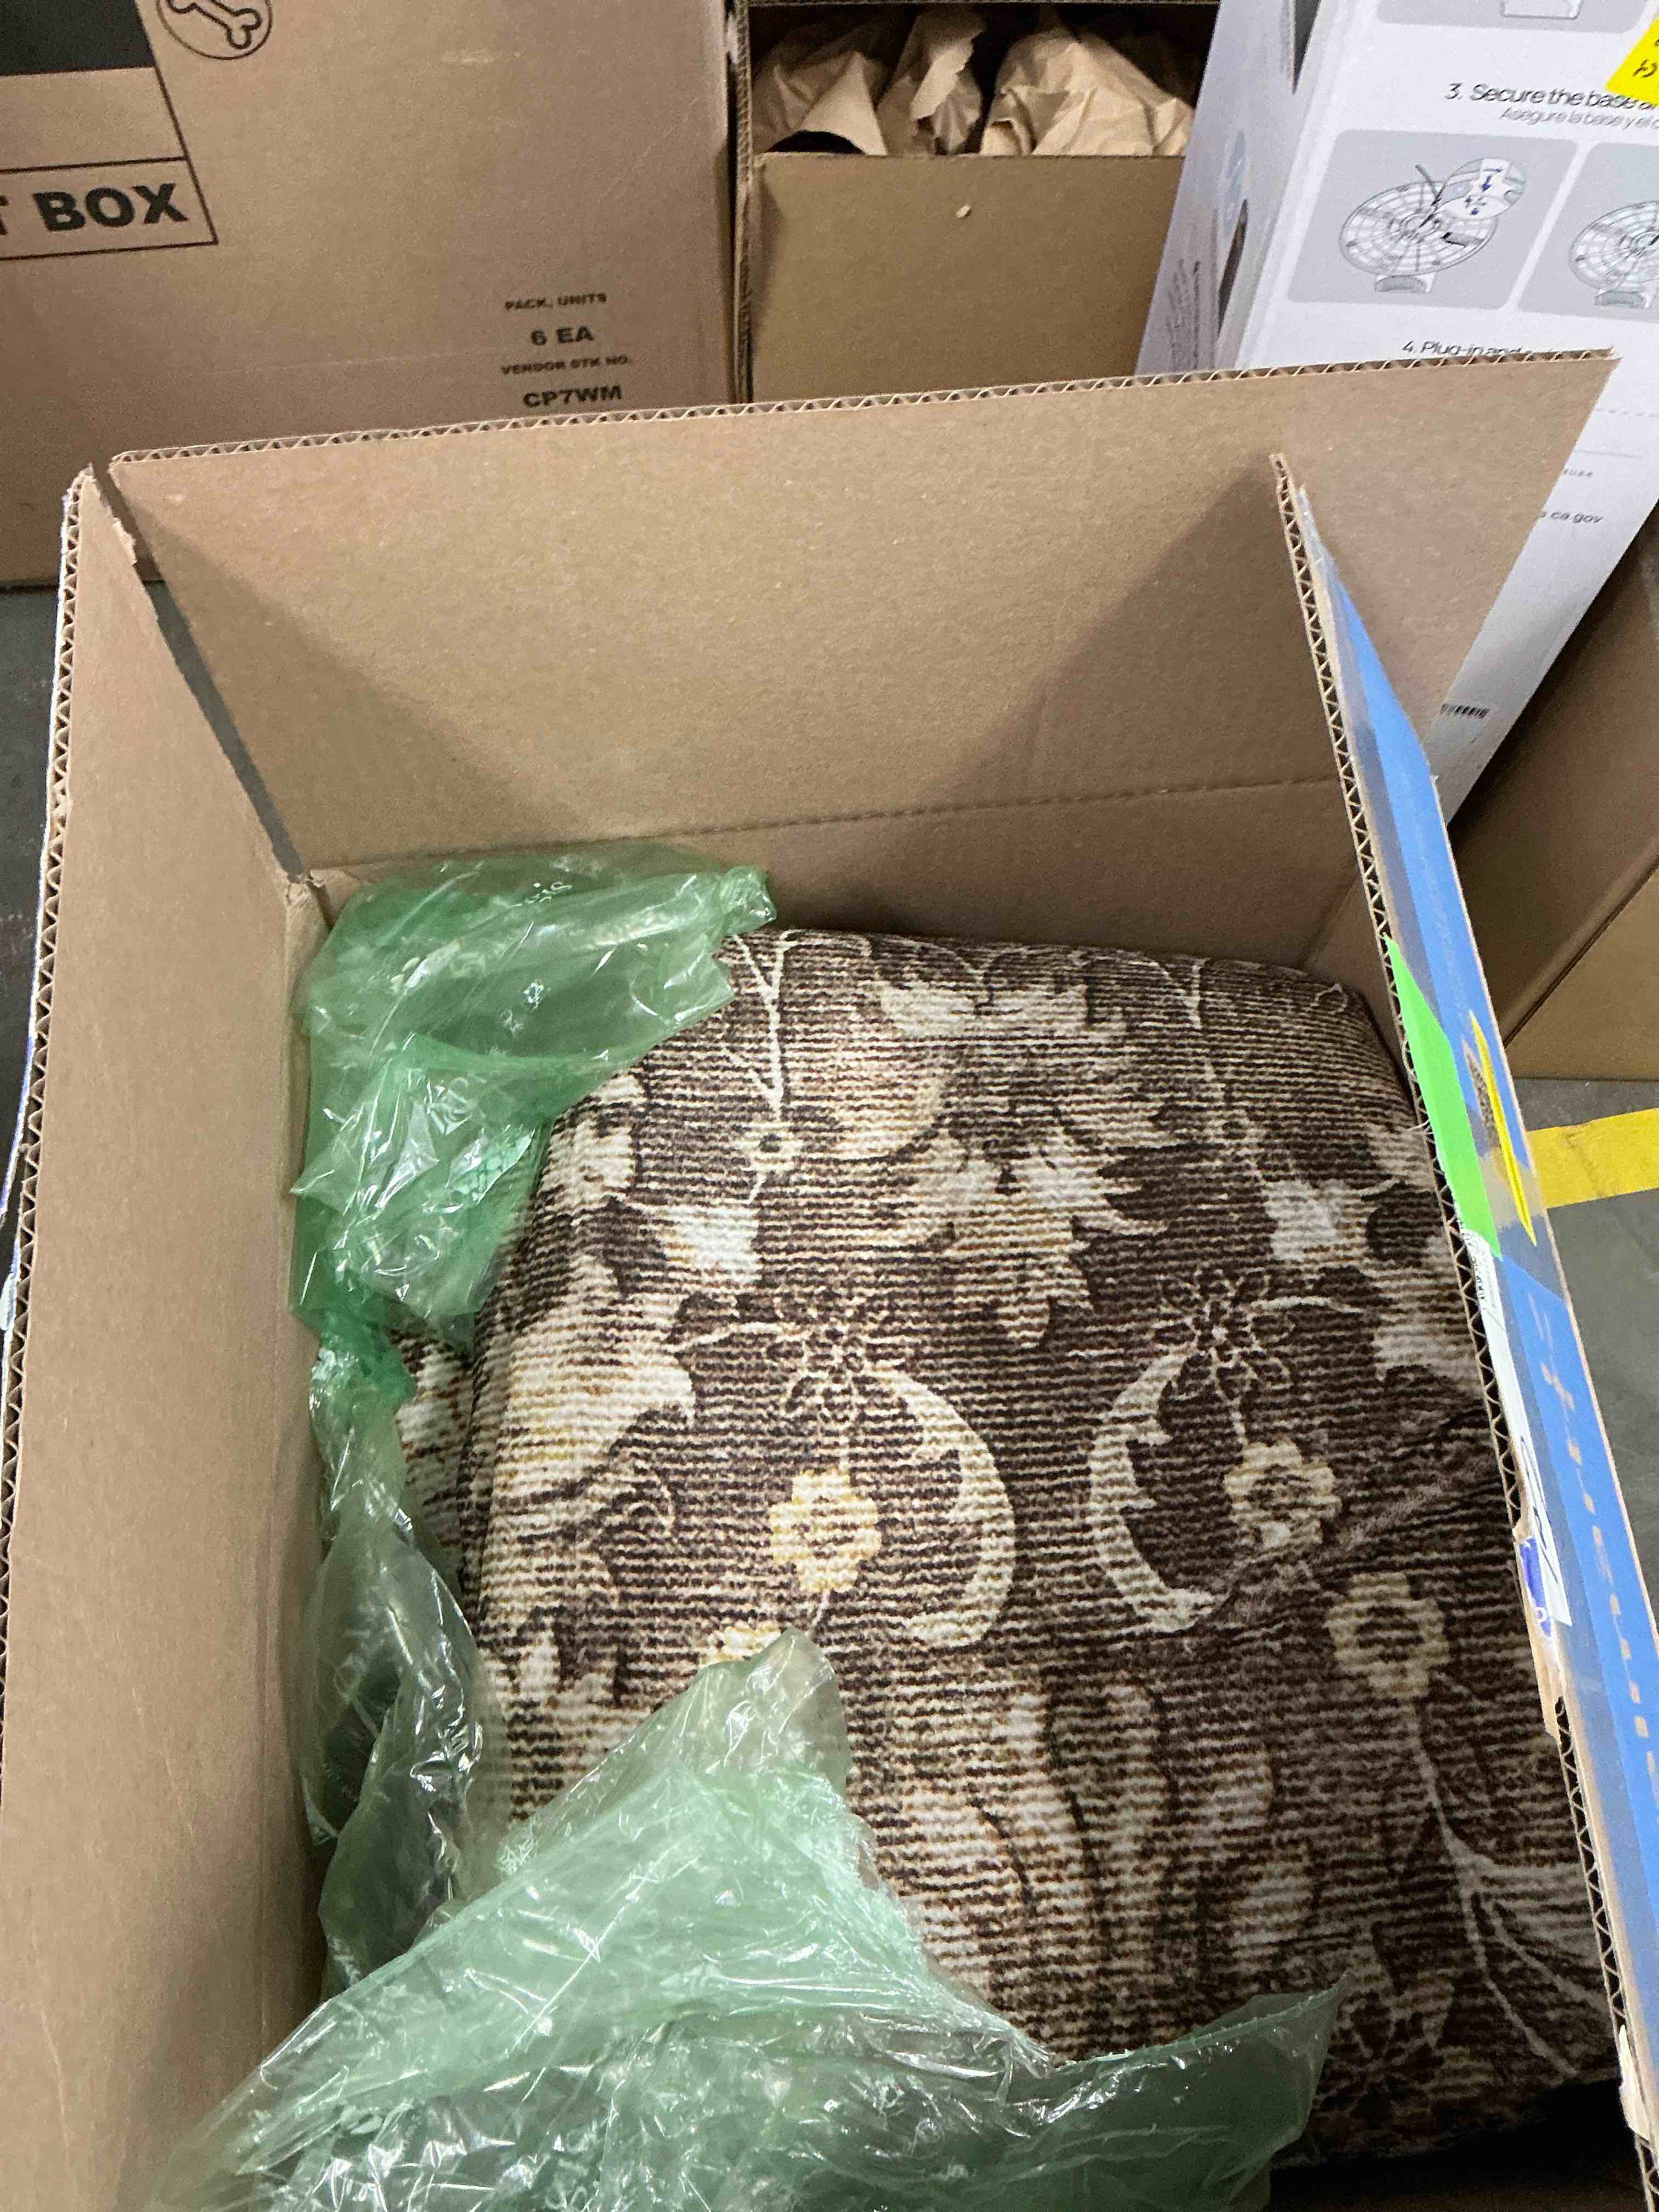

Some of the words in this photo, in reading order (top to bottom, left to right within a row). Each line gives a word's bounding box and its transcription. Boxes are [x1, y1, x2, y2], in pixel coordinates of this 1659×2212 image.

[1469, 83, 1546, 104] Secure
[1547, 87, 1585, 106] the
[32, 182, 188, 232] BOX
[558, 292, 607, 306] UNITS
[531, 330, 548, 346] 6
[556, 326, 596, 344] EA
[501, 360, 566, 375] VENDOR
[523, 385, 623, 408] CP7WM
